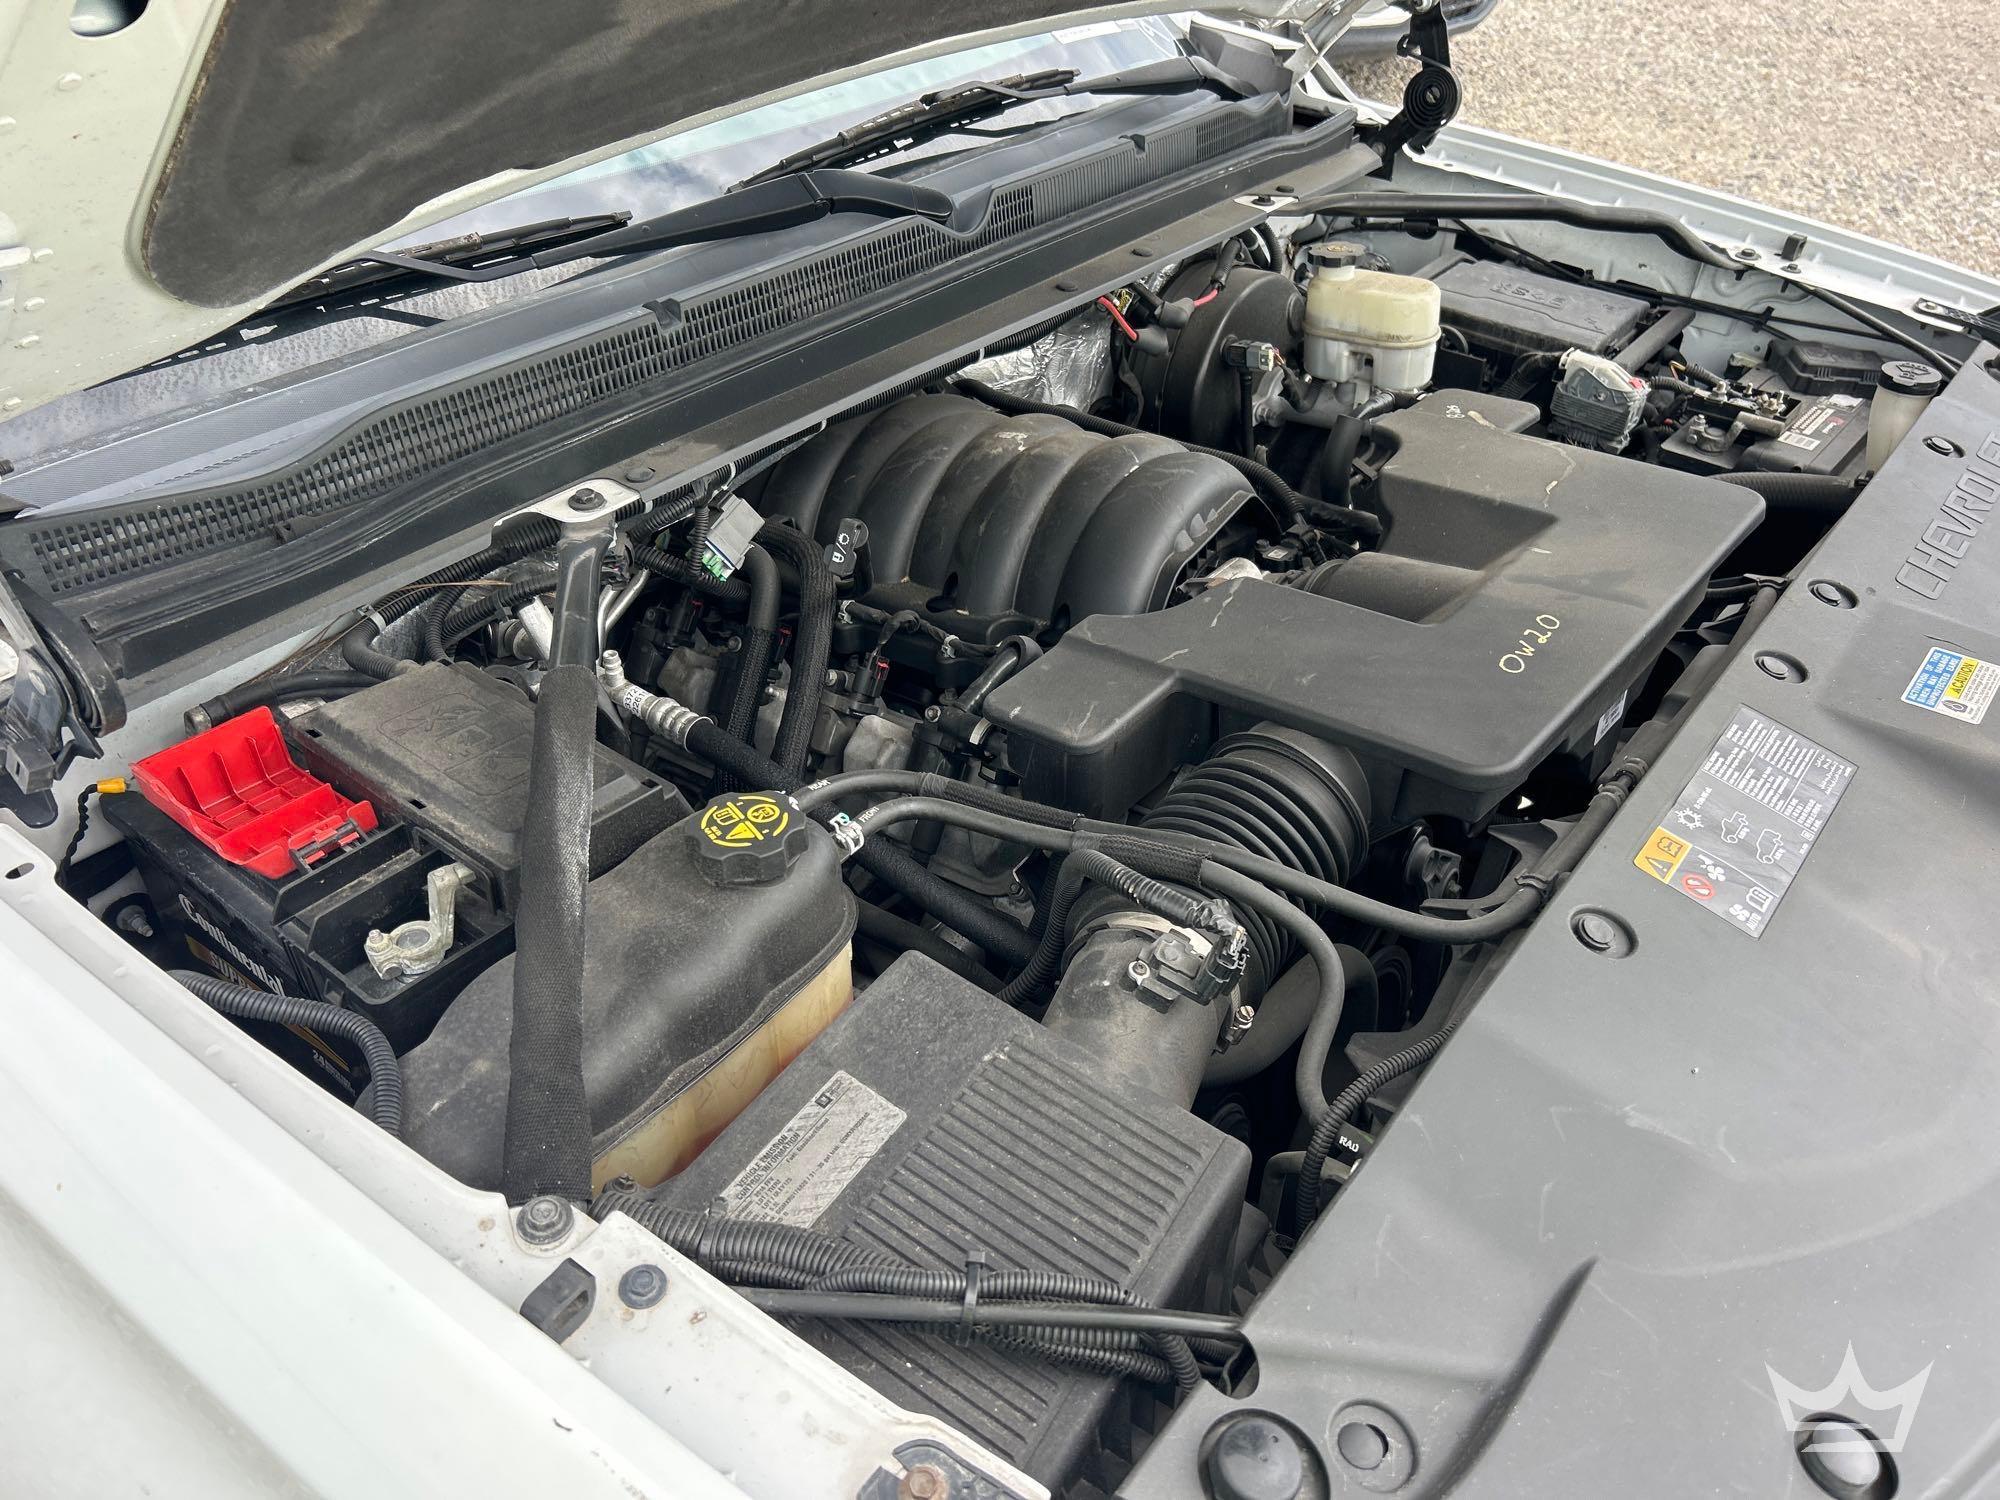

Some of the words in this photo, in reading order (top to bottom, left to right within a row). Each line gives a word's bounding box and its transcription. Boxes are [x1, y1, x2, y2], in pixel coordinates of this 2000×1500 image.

[1908, 672, 1930, 700] ACTIVATION
[1952, 663, 1975, 691] CAUTION
[808, 779, 831, 791] REAR
[859, 806, 880, 823] FRONT
[179, 893, 286, 997] Continental
[1338, 1135, 1360, 1153] RAD
[736, 1161, 760, 1188] VEHICLE
[760, 1133, 789, 1163] EMISSION
[736, 1173, 764, 1200] CONTROL
[761, 1131, 800, 1173] INFORMATION
